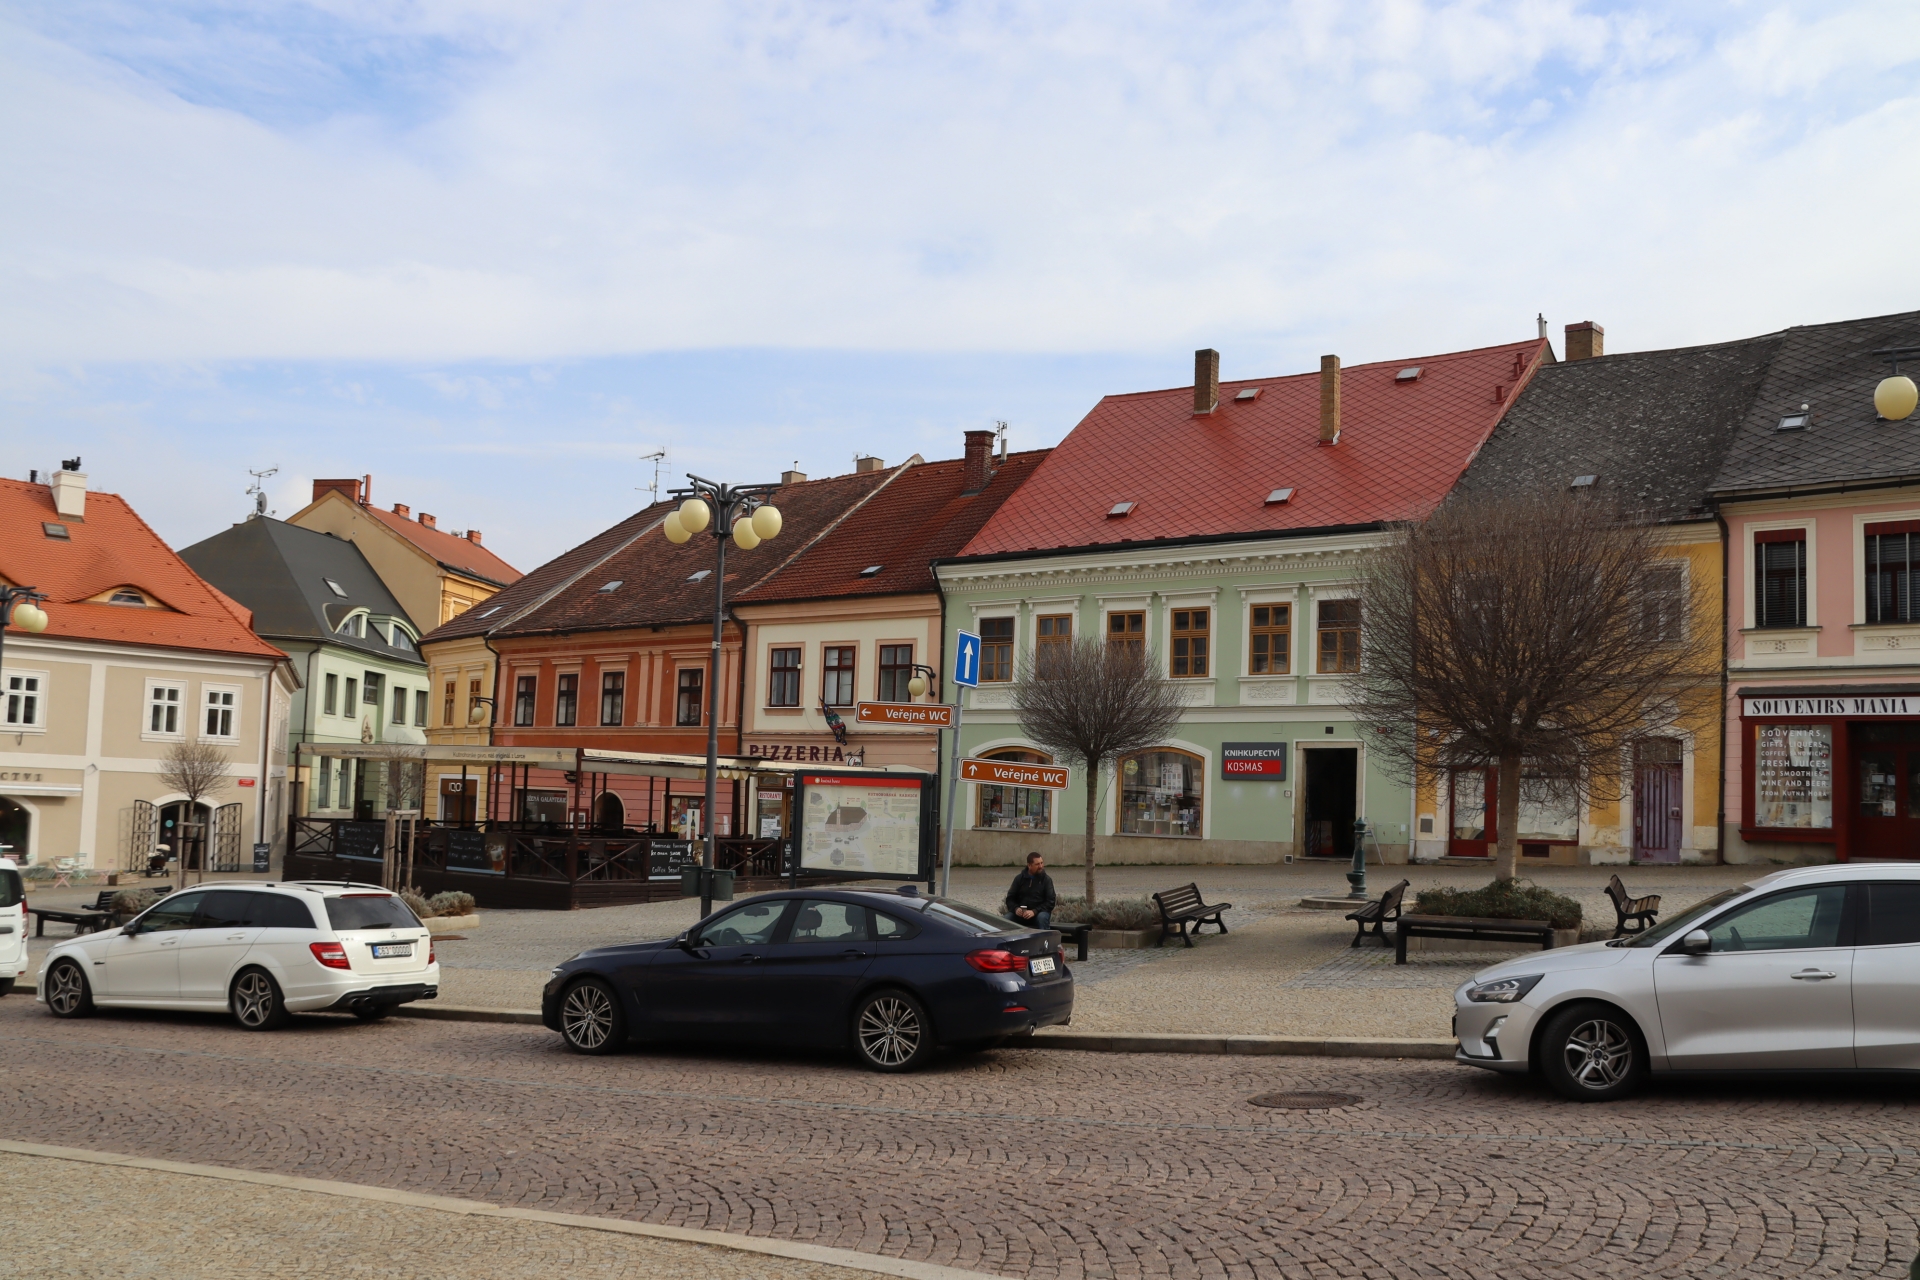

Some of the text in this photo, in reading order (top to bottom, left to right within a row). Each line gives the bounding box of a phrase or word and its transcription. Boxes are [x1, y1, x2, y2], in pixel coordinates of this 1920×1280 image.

[1752, 698, 1908, 715] SOUVENIRS MANIA
[885, 708, 948, 722] Veřejné WC
[1761, 730, 1826, 738] SOUVENIRS,
[1761, 741, 1826, 749] GIFTS, LIQUERS,
[749, 744, 844, 762] PIZZERIA
[1224, 748, 1280, 757] KNIHKUPECTVÍ
[1227, 762, 1263, 772] KOSMAS
[993, 767, 1064, 784] Veřejné WC
